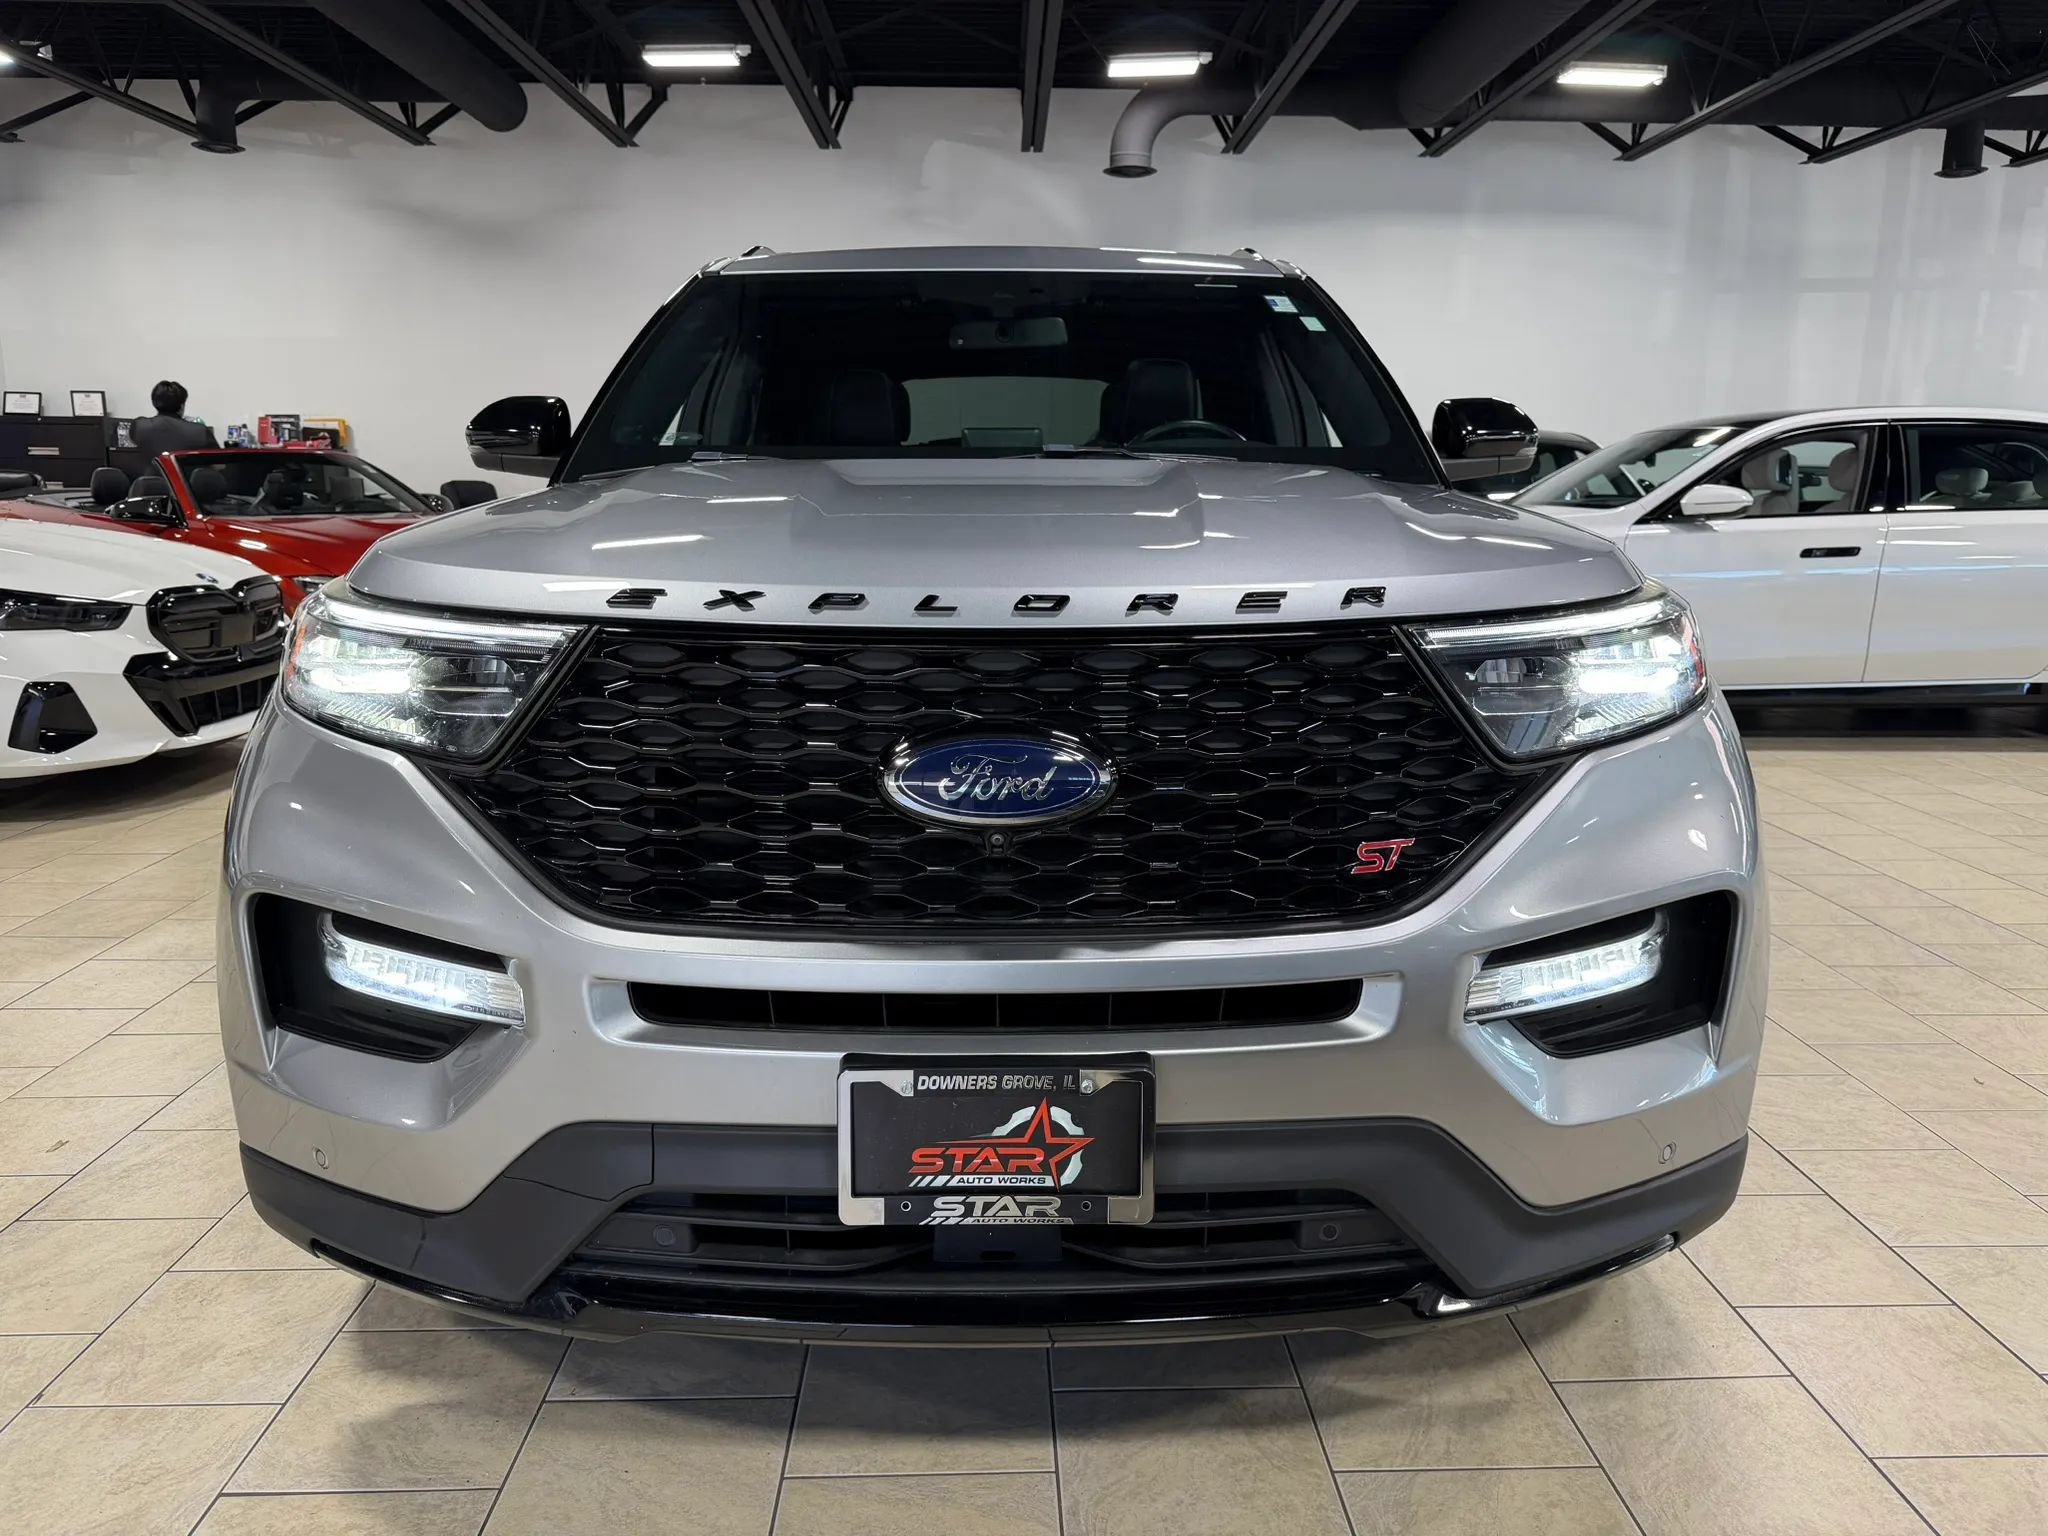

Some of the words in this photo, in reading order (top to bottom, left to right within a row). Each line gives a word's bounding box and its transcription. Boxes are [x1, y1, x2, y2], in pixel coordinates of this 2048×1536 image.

[605, 586, 1386, 614] EXPLORER
[938, 754, 1057, 801] Ford
[1350, 838, 1416, 874] ST
[917, 1075, 998, 1090] DOWNERS
[1001, 1075, 1057, 1091] GROVE,
[1063, 1075, 1076, 1090] IL
[908, 1147, 1045, 1174] STAR
[956, 1177, 993, 1185] AUTO
[998, 1177, 1046, 1185] WORKS
[930, 1196, 1062, 1217] STAR
